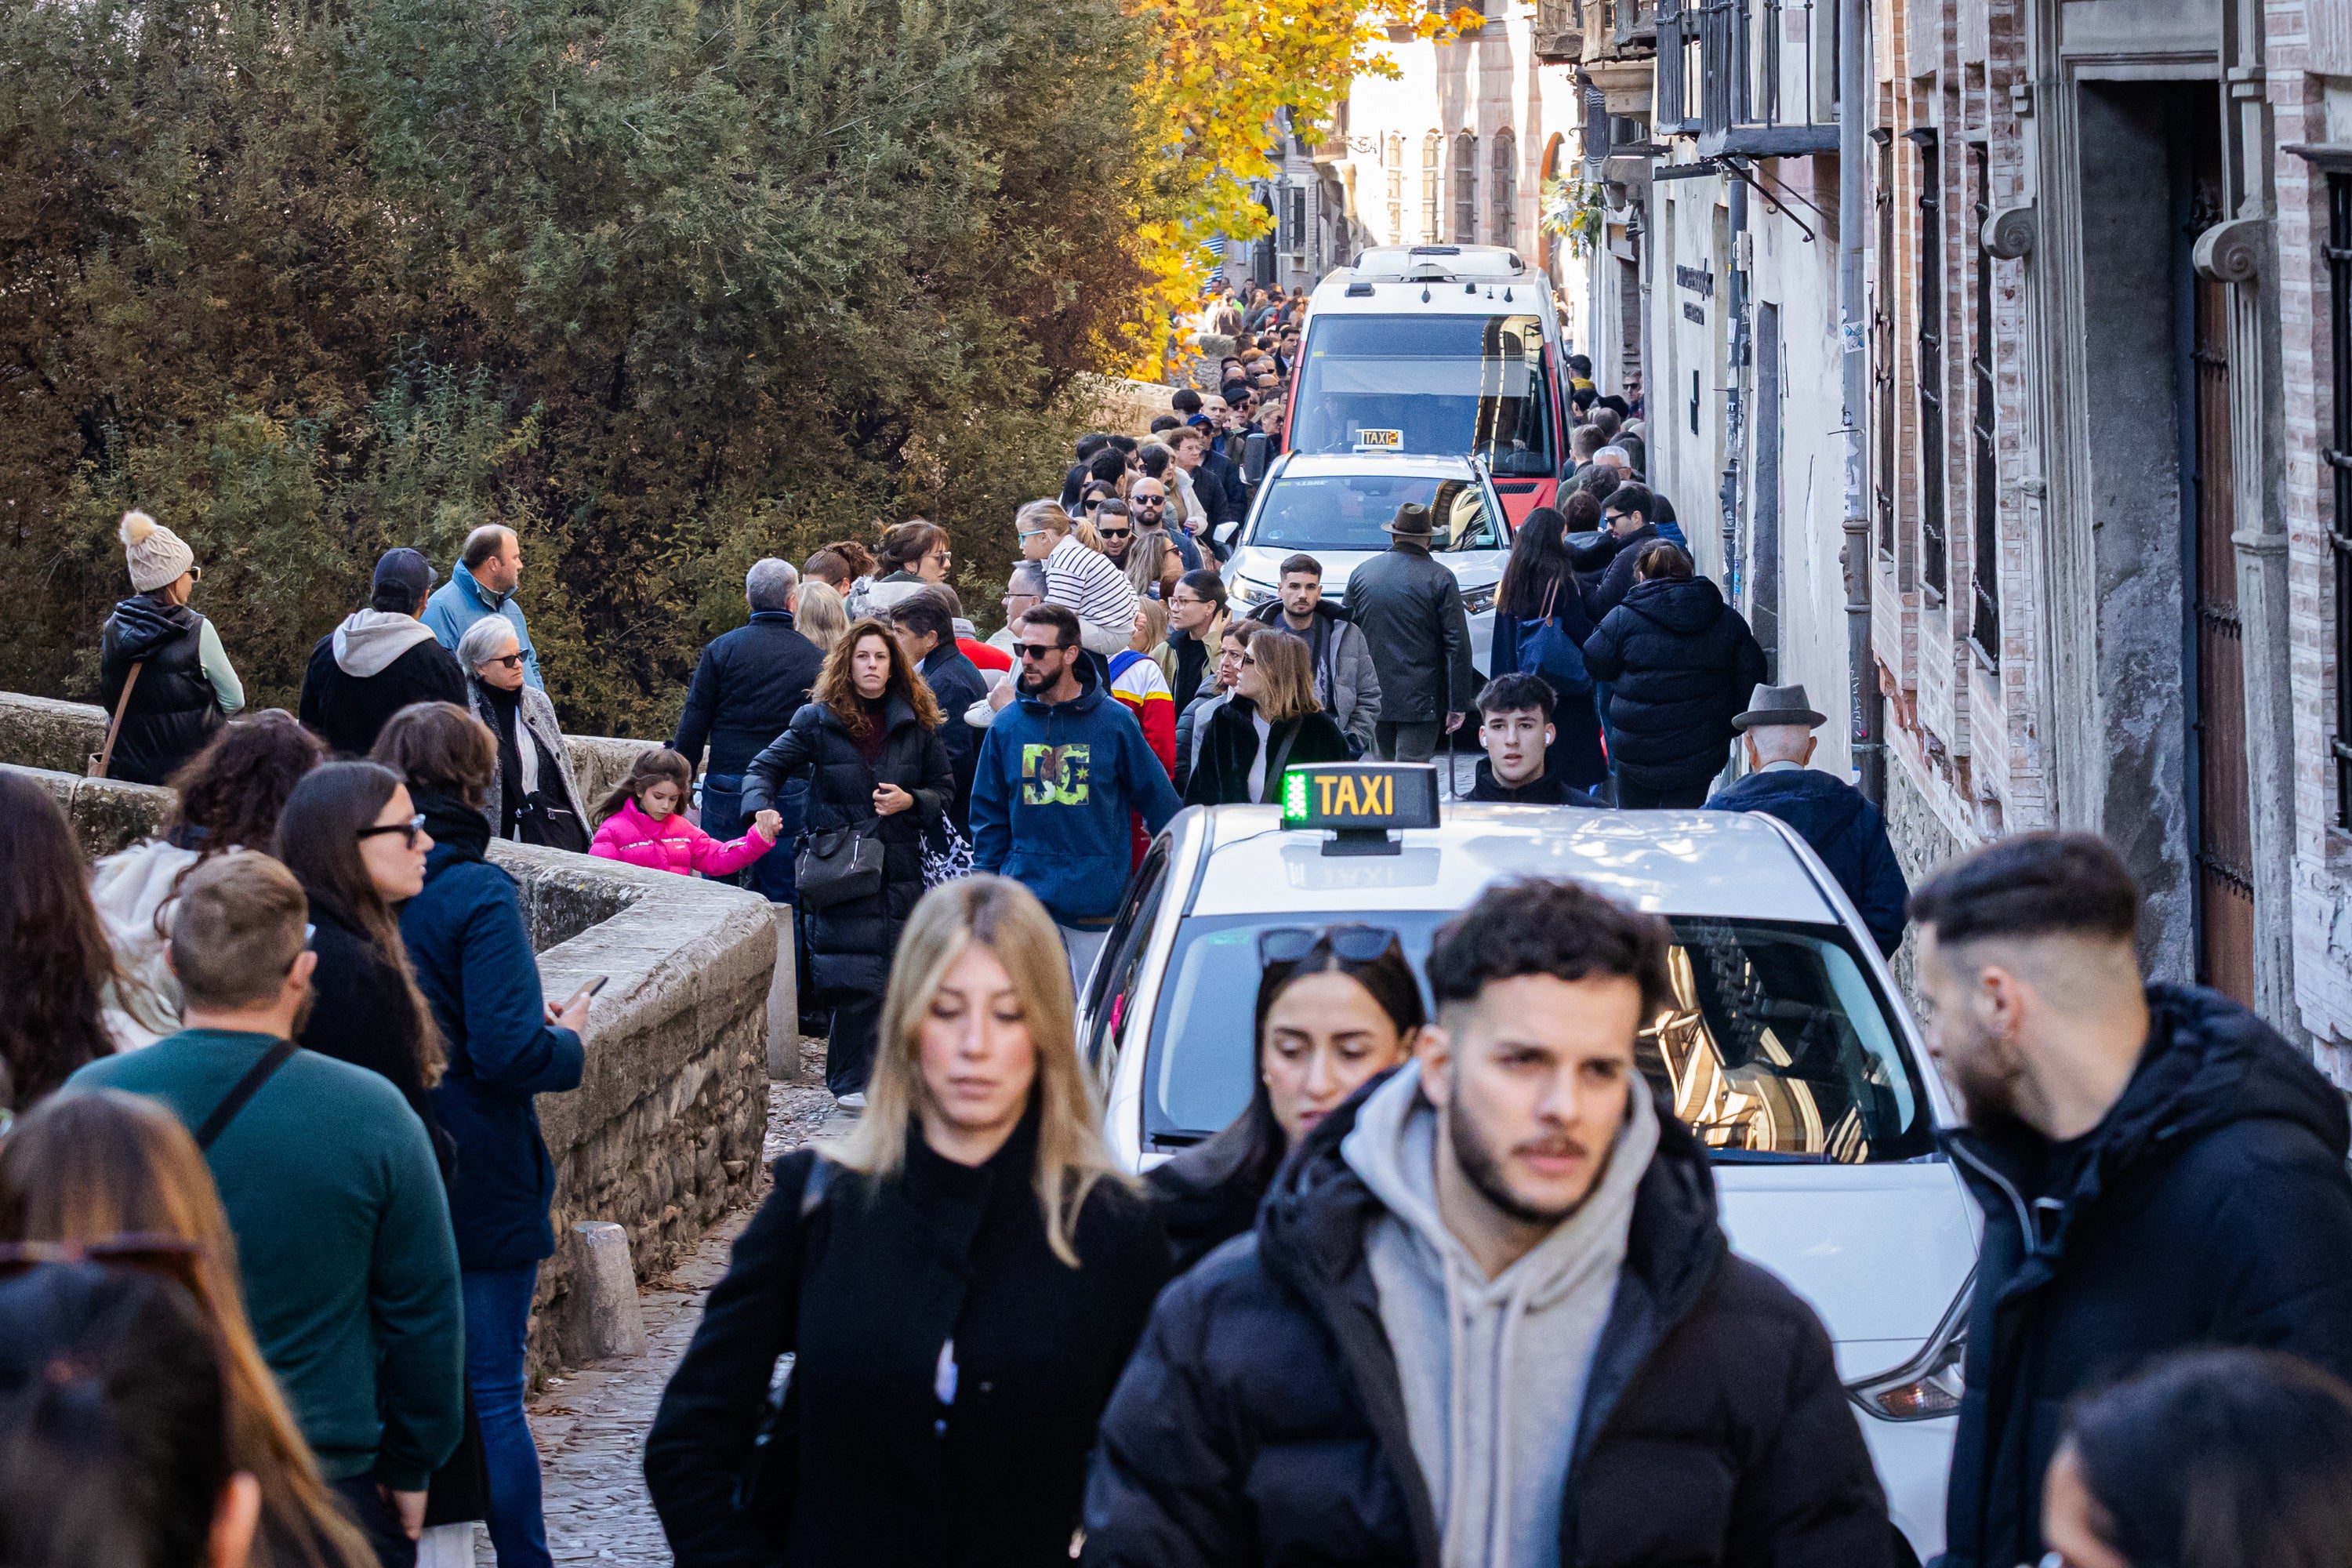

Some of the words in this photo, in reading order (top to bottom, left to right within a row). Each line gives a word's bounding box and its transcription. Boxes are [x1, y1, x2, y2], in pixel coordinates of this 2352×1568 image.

[1364, 431, 1388, 445] TAXI
[1022, 743, 1091, 806] DC
[1314, 775, 1394, 816] TAXI
